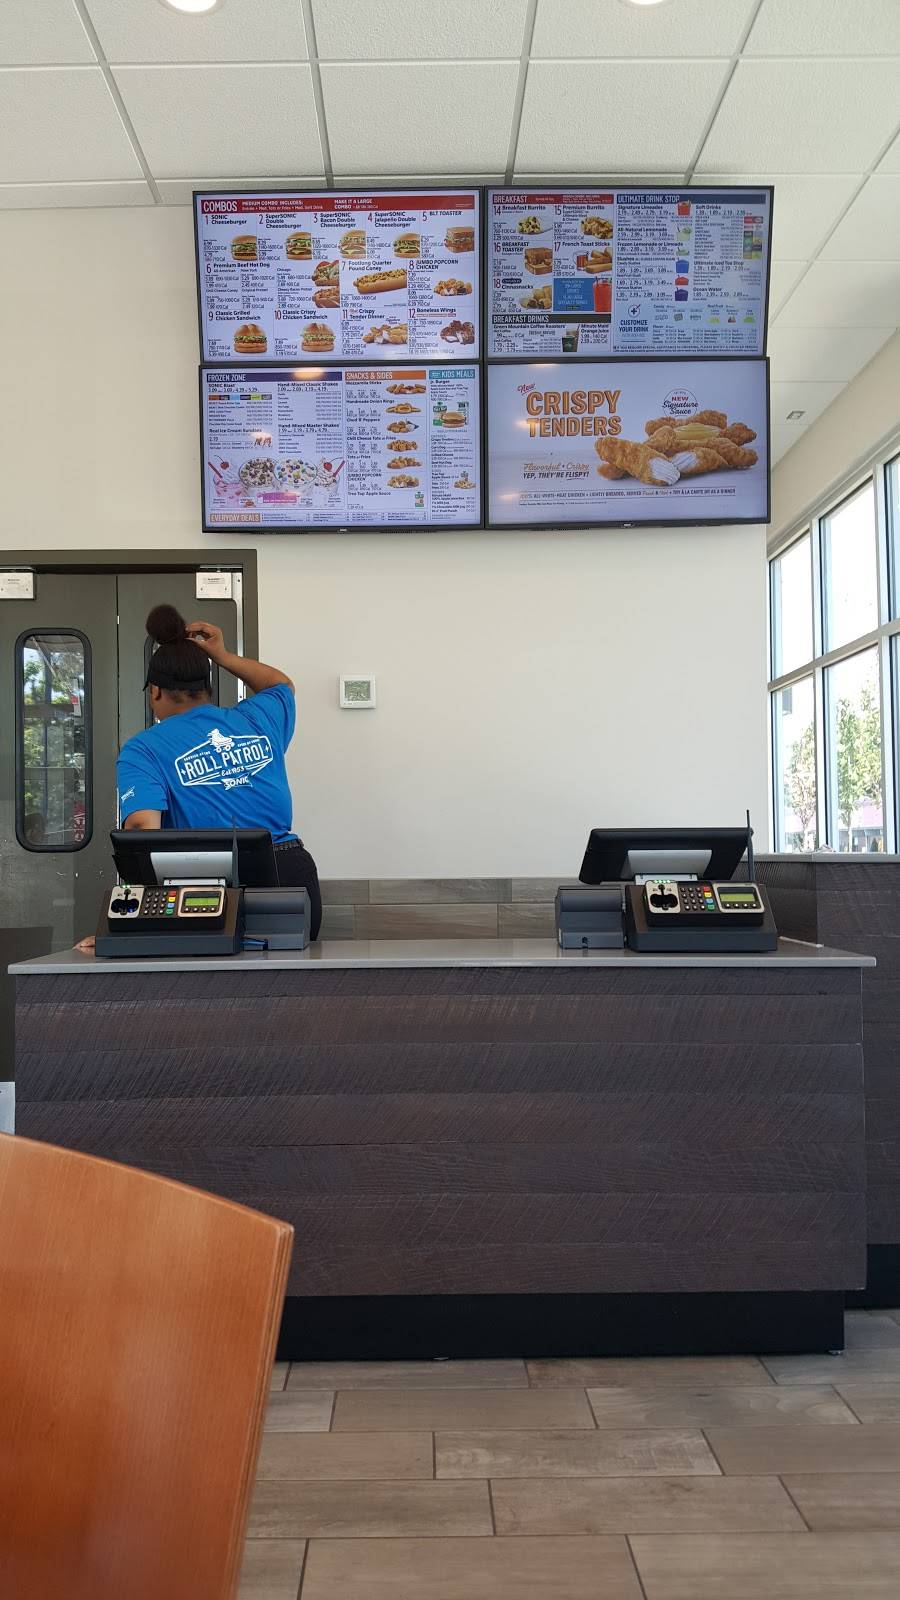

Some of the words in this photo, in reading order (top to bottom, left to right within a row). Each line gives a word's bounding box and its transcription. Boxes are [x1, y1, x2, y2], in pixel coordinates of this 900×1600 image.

[617, 195, 645, 203] ULTIMATE
[646, 195, 664, 203] DRINK
[664, 195, 680, 203] STOP
[203, 201, 237, 212] COMBOS
[493, 206, 501, 216] 14
[258, 215, 264, 224] 2
[313, 213, 318, 223] 3
[368, 212, 373, 222] 4
[422, 212, 427, 222] 5
[494, 242, 501, 252] 16
[554, 242, 560, 252] 17
[207, 263, 211, 273] 6
[409, 260, 414, 270] 8
[493, 279, 501, 289] 18
[208, 311, 213, 321] 9
[275, 310, 281, 320] 10
[342, 310, 348, 319] 11
[409, 308, 416, 318] 12
[494, 315, 526, 323] BREAKFAST
[208, 374, 230, 382] FROZEN
[346, 372, 369, 380] SNACKS
[526, 390, 621, 416] CRISPY
[662, 400, 699, 409] Signature
[526, 416, 622, 437] TENDERS
[523, 462, 561, 472] Flavorful
[566, 462, 589, 472] Crispy
[523, 472, 537, 480] YEP,
[184, 755, 222, 780] ROLL
[221, 743, 268, 767] PATROL
[224, 775, 249, 788] SONIC
